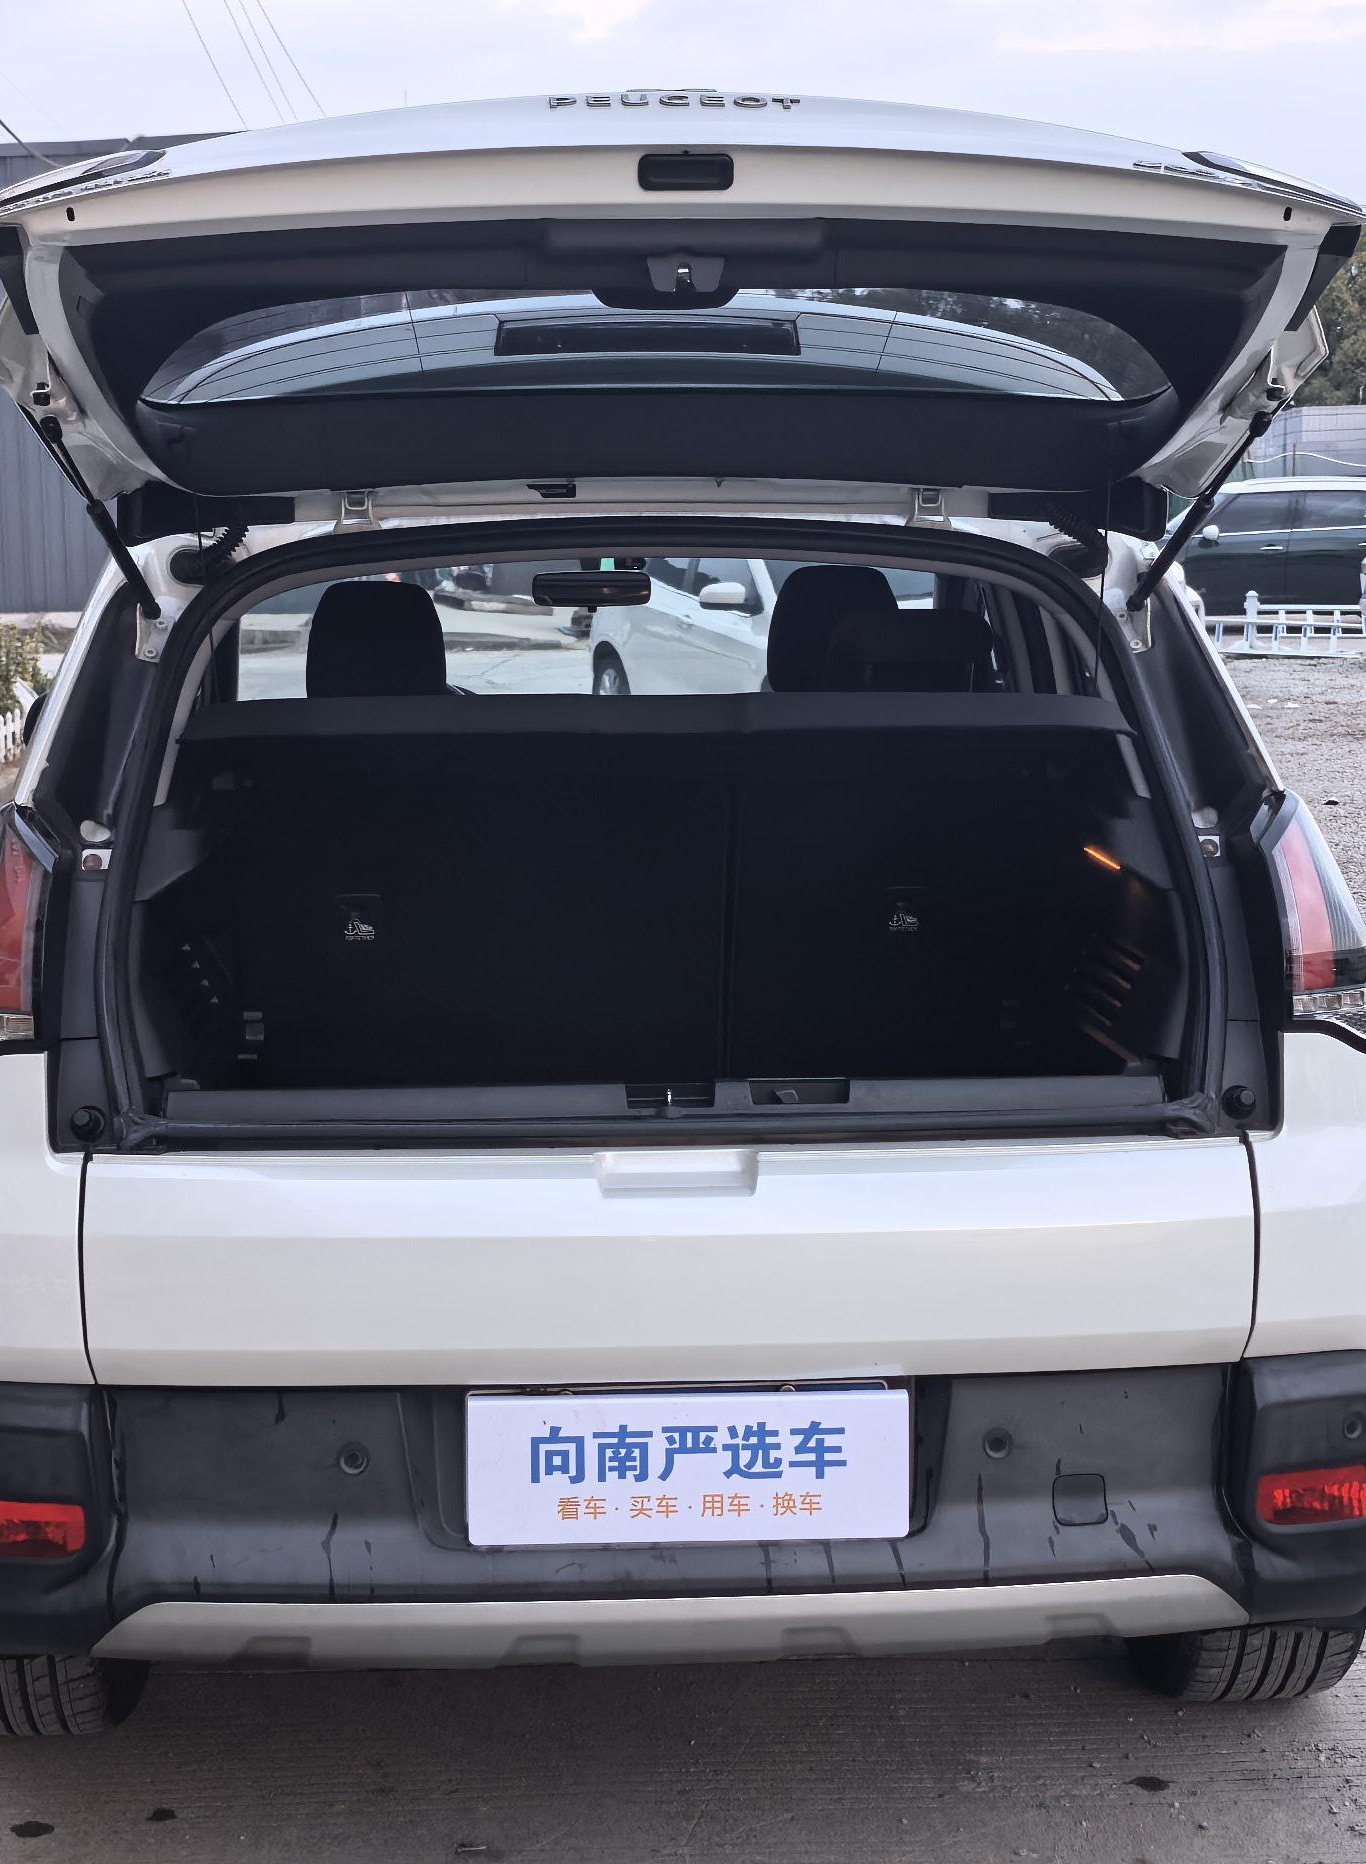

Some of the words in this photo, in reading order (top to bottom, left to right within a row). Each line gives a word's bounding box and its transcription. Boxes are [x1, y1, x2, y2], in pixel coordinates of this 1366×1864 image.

[548, 93, 801, 110] PEUGEOT
[530, 1420, 848, 1484] 向南严选车
